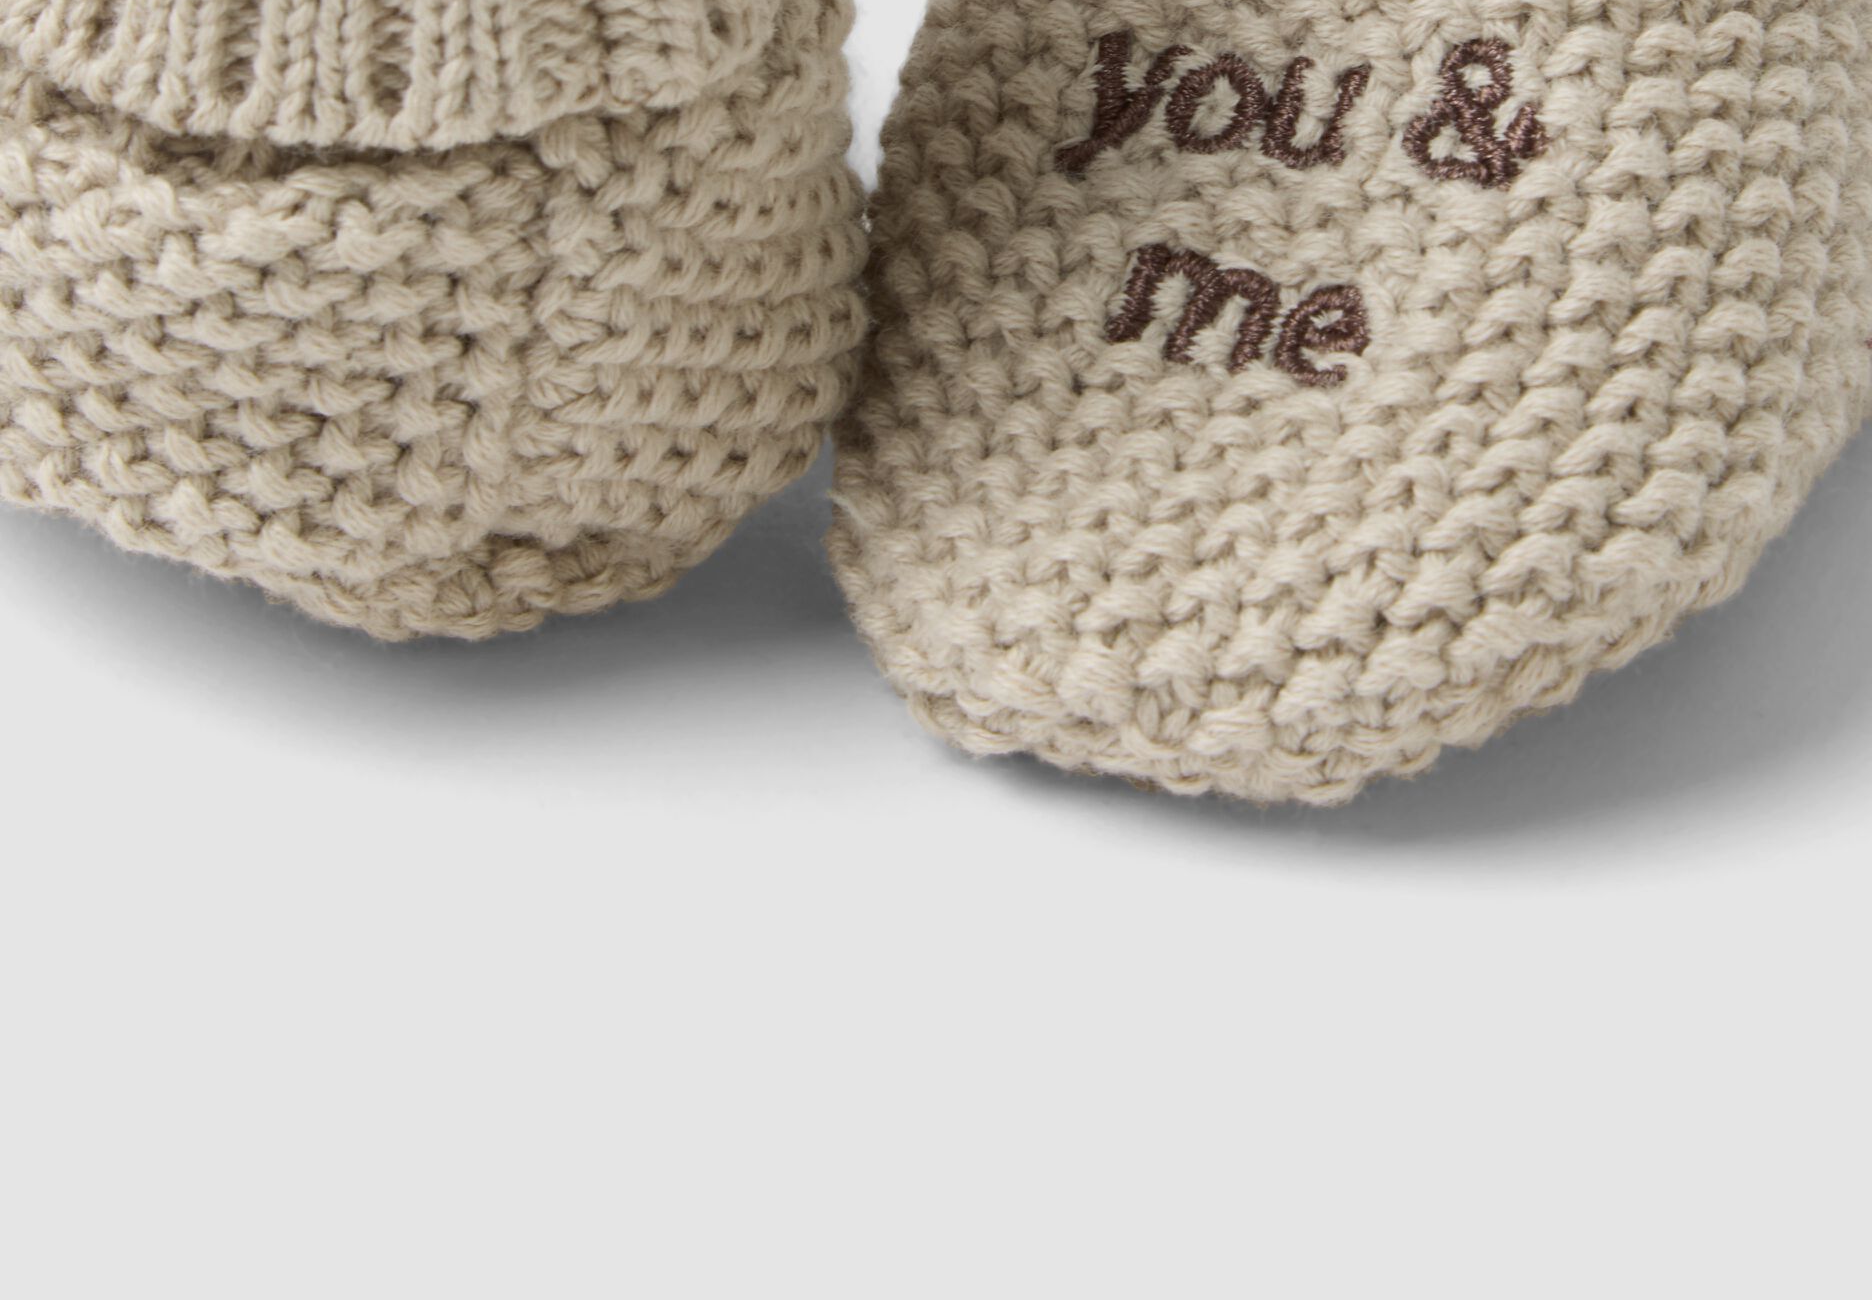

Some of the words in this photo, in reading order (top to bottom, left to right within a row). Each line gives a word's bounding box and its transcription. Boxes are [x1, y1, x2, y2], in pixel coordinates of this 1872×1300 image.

[1055, 30, 1371, 179] you
[1403, 37, 1549, 189] &
[1104, 243, 1370, 387] me
